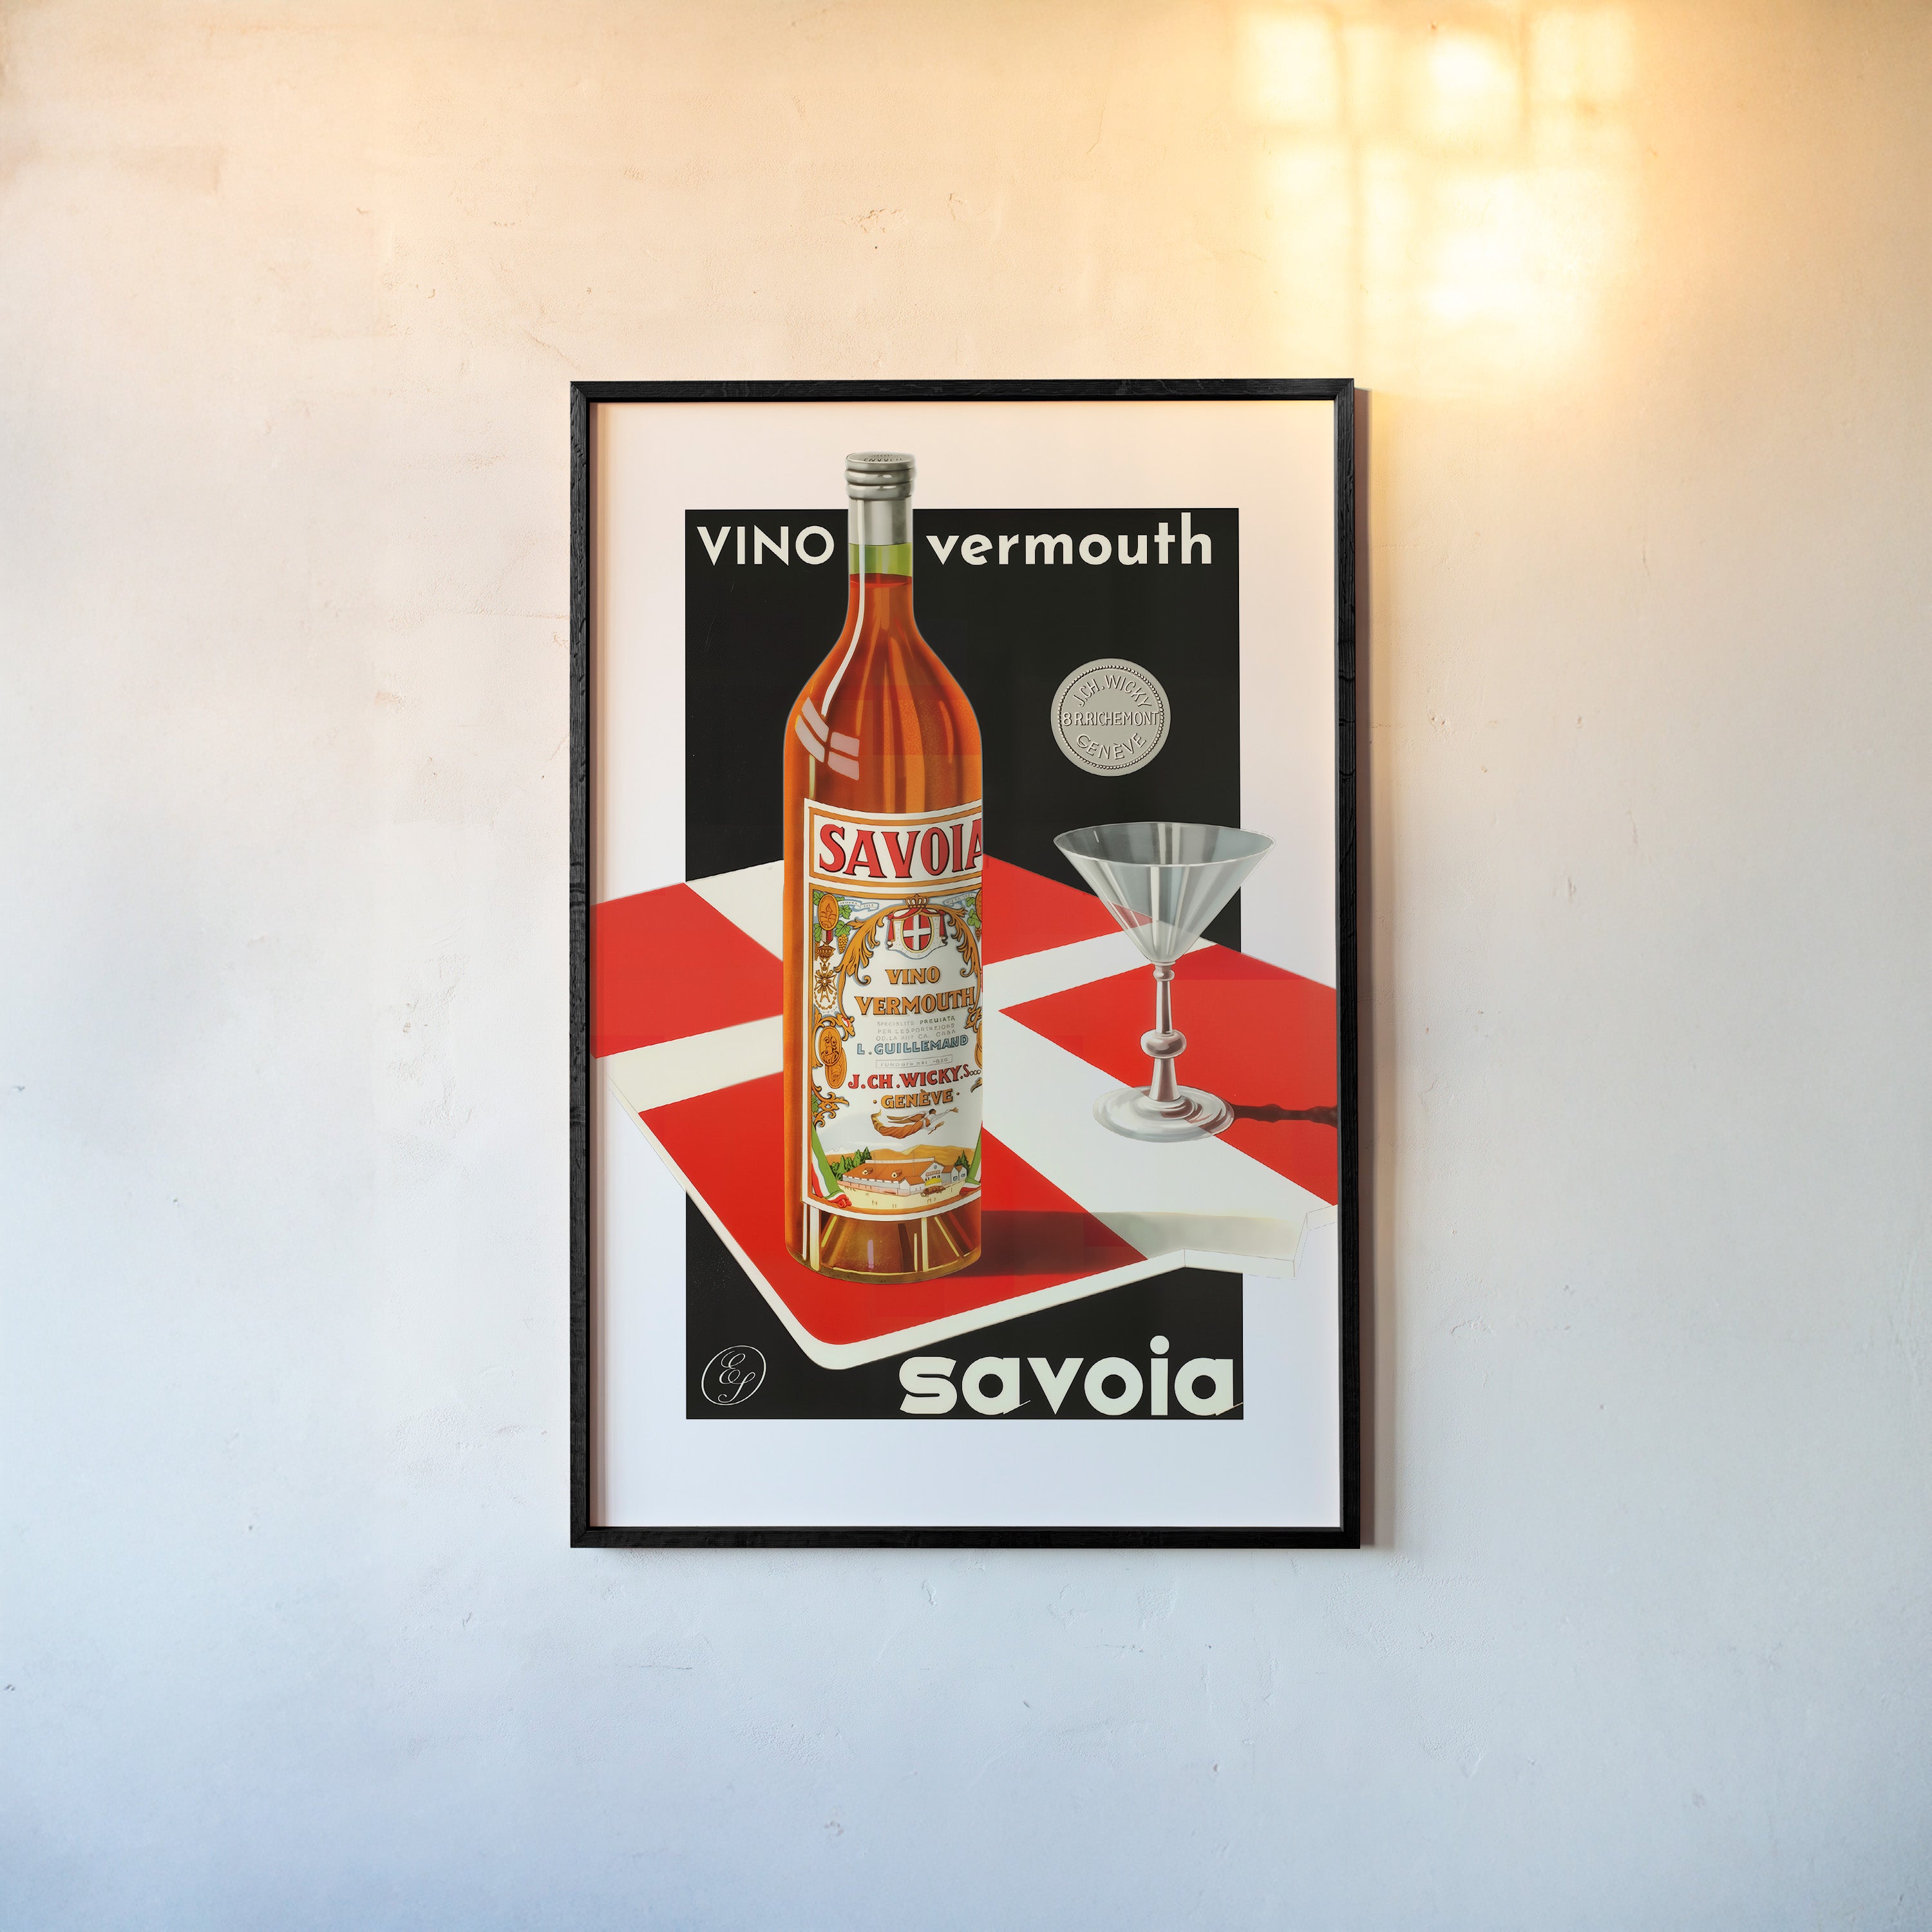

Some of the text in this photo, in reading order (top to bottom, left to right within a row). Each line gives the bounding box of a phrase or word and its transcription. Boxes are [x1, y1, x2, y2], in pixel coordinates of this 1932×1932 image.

[697, 512, 1212, 566] VINO vermouth
[1076, 732, 1146, 760] GENÈVE
[886, 965, 940, 985] VINO
[854, 986, 976, 1016] VERMOUTH
[880, 1088, 954, 1109] GENÈVE
[899, 1335, 1235, 1416] savoia
